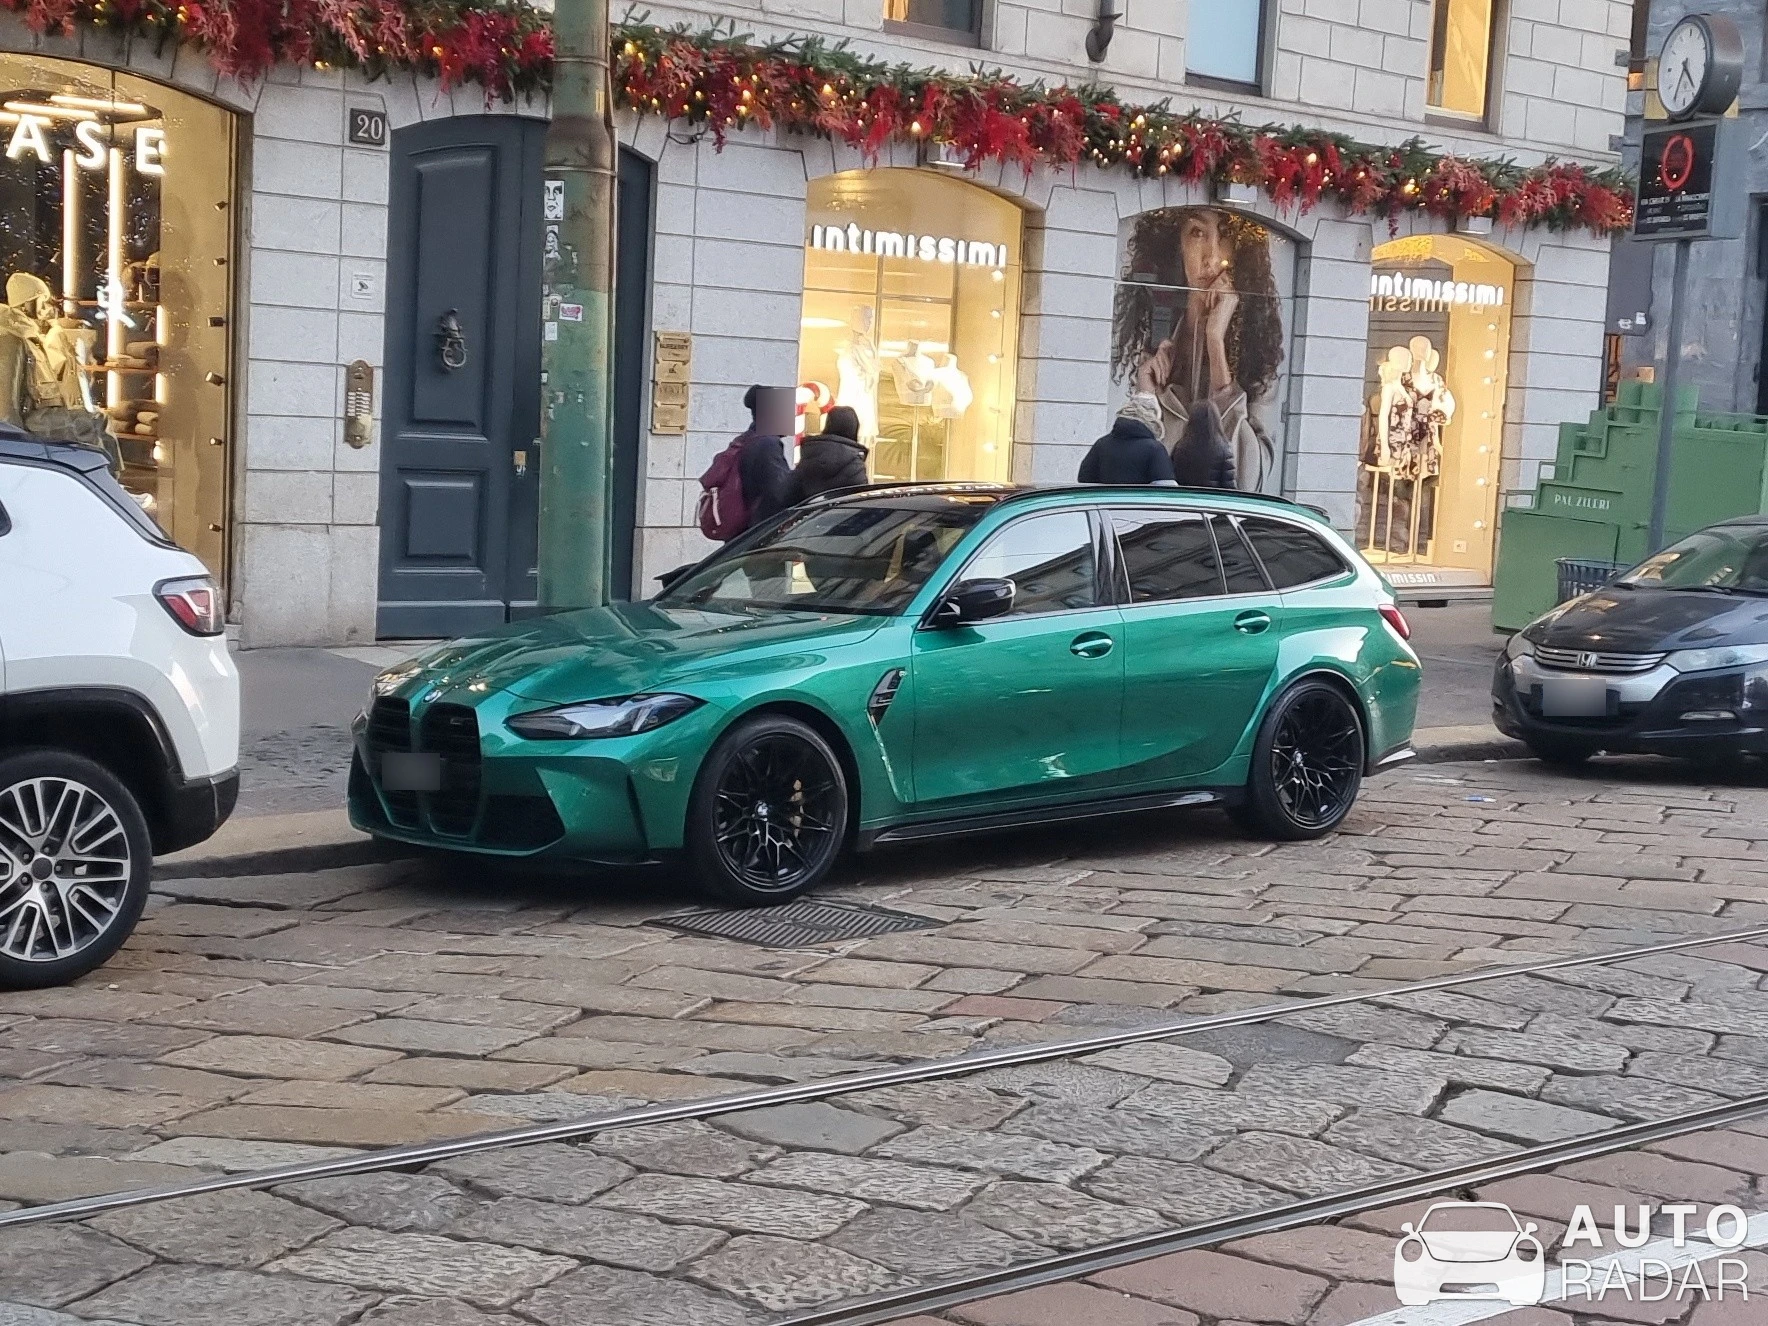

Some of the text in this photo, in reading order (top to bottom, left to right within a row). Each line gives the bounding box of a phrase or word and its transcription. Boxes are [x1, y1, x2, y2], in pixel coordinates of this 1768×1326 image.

[6, 114, 167, 175] ASE
[357, 114, 383, 140] 20
[812, 222, 1007, 269] intimissimi
[1371, 271, 1504, 306] intimissimi
